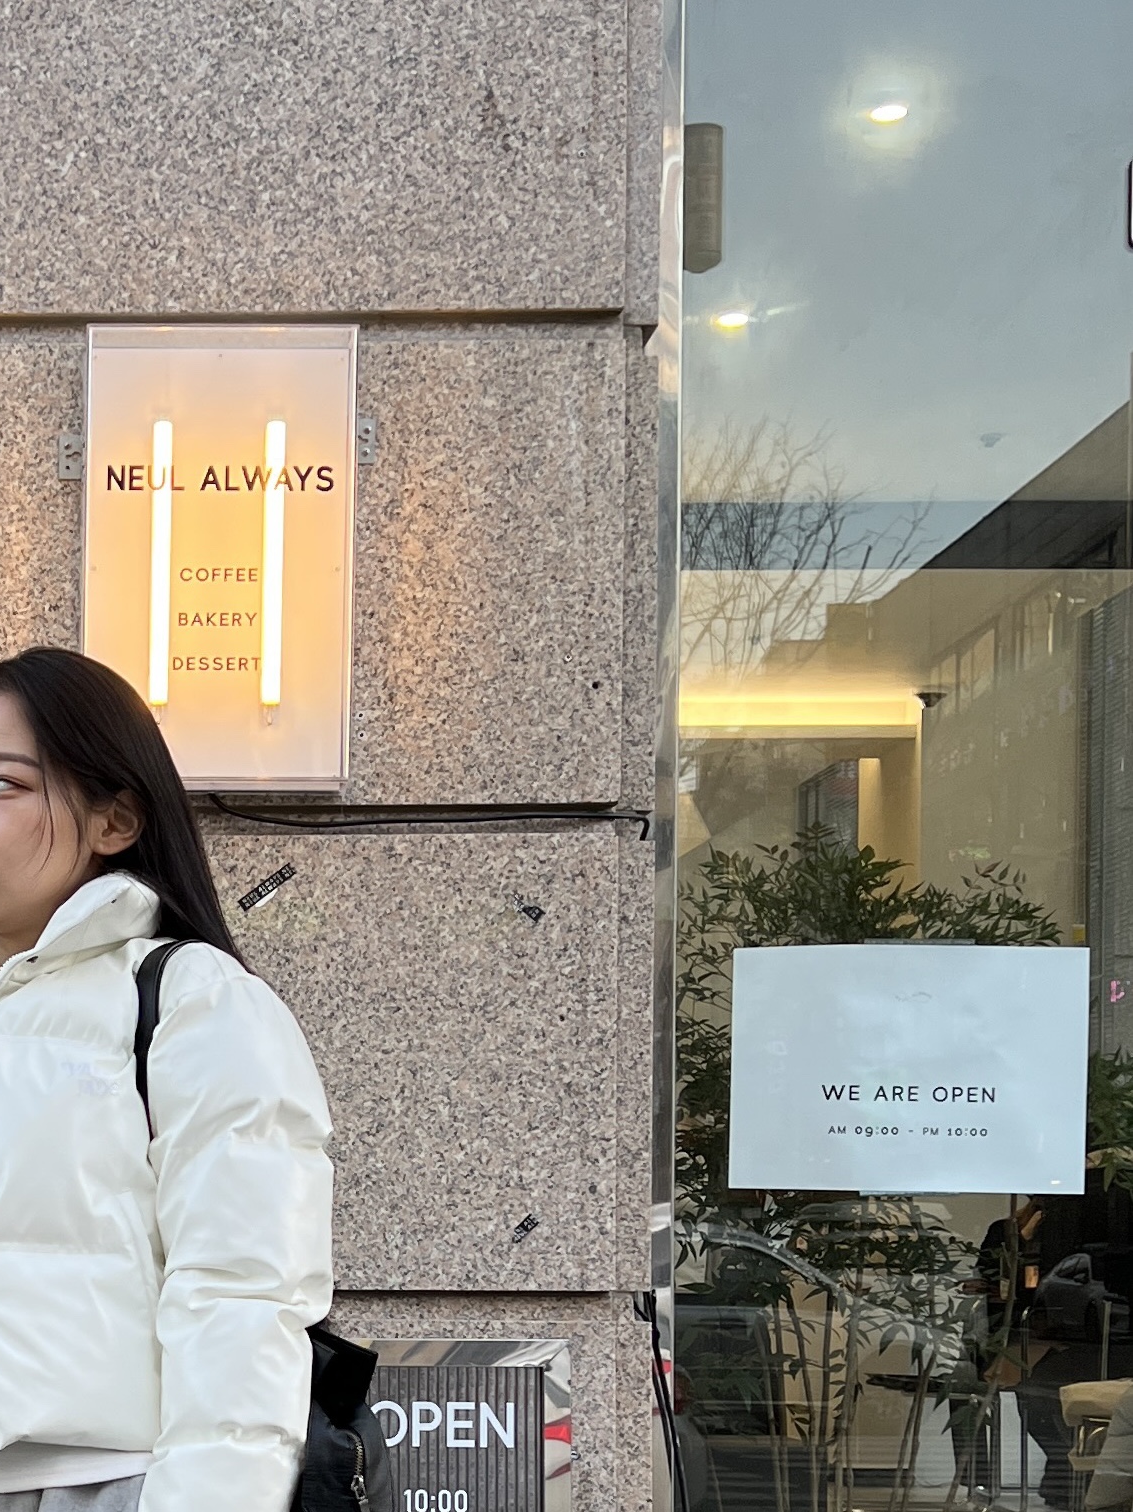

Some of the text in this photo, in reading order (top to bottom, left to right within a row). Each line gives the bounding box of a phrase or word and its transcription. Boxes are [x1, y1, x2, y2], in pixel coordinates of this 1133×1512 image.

[107, 465, 334, 492] NEUL ALWAYS
[180, 567, 258, 582] COFFEE
[178, 612, 258, 627] BAKERY
[172, 656, 261, 671] DESSERT
[822, 1084, 996, 1103] WE ARE OPEN
[827, 1125, 847, 1135] AM
[854, 1125, 899, 1137] 09:00
[923, 1127, 939, 1136] PM
[947, 1127, 988, 1137] 10:00
[371, 1401, 515, 1449] OPEN
